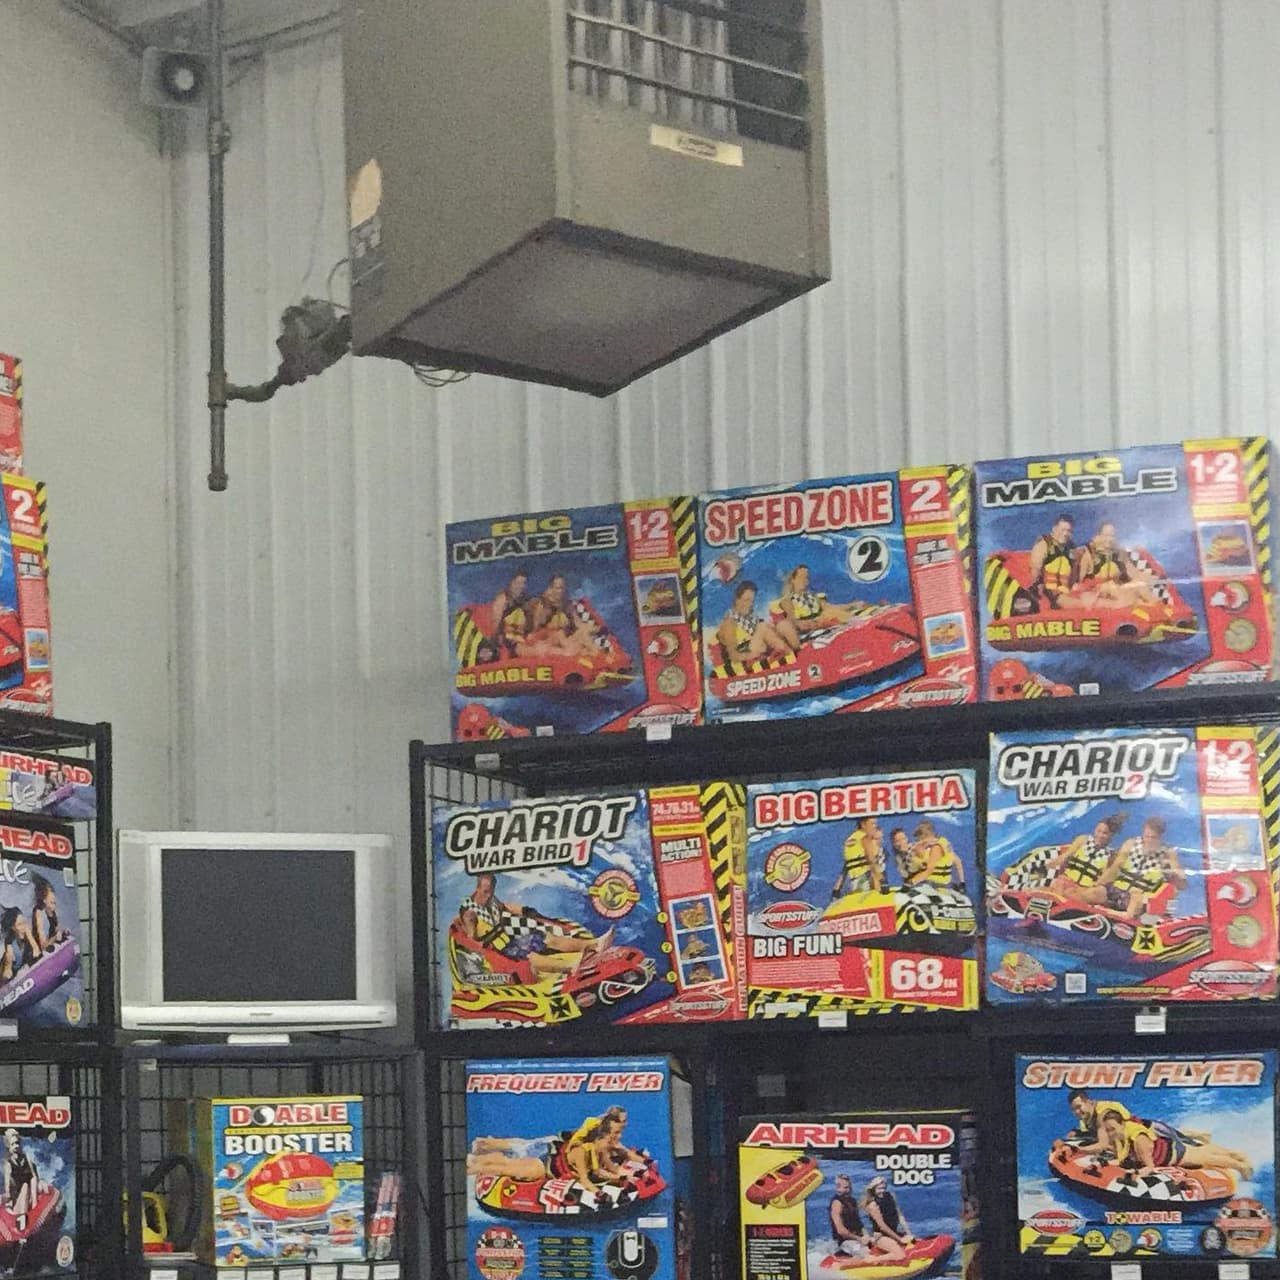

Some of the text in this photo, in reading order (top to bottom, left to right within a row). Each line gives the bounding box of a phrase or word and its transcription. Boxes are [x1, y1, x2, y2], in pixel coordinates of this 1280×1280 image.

[1026, 457, 1121, 479] BIG
[1191, 453, 1239, 483] 1-2
[910, 480, 942, 511] 2
[982, 468, 1178, 508] MABLE
[12, 492, 35, 525] 2
[491, 515, 571, 538] BIG
[453, 525, 618, 564] MABLE
[858, 541, 882, 573] 2
[999, 737, 1189, 784] CHARIOT
[756, 776, 968, 827] BIG BERTHA
[1023, 782, 1067, 797] WAR
[448, 798, 636, 855] CHARIOT
[753, 934, 842, 958] BIG FUN!
[466, 1072, 663, 1092] FREQUENT FLYER
[1023, 1061, 1264, 1088] STUNT FLYER
[224, 1132, 354, 1154] BOOSTER
[744, 1123, 955, 1148] AIRHEAD
[876, 1154, 951, 1169] DOUBLE
[893, 1170, 934, 1184] DOG
